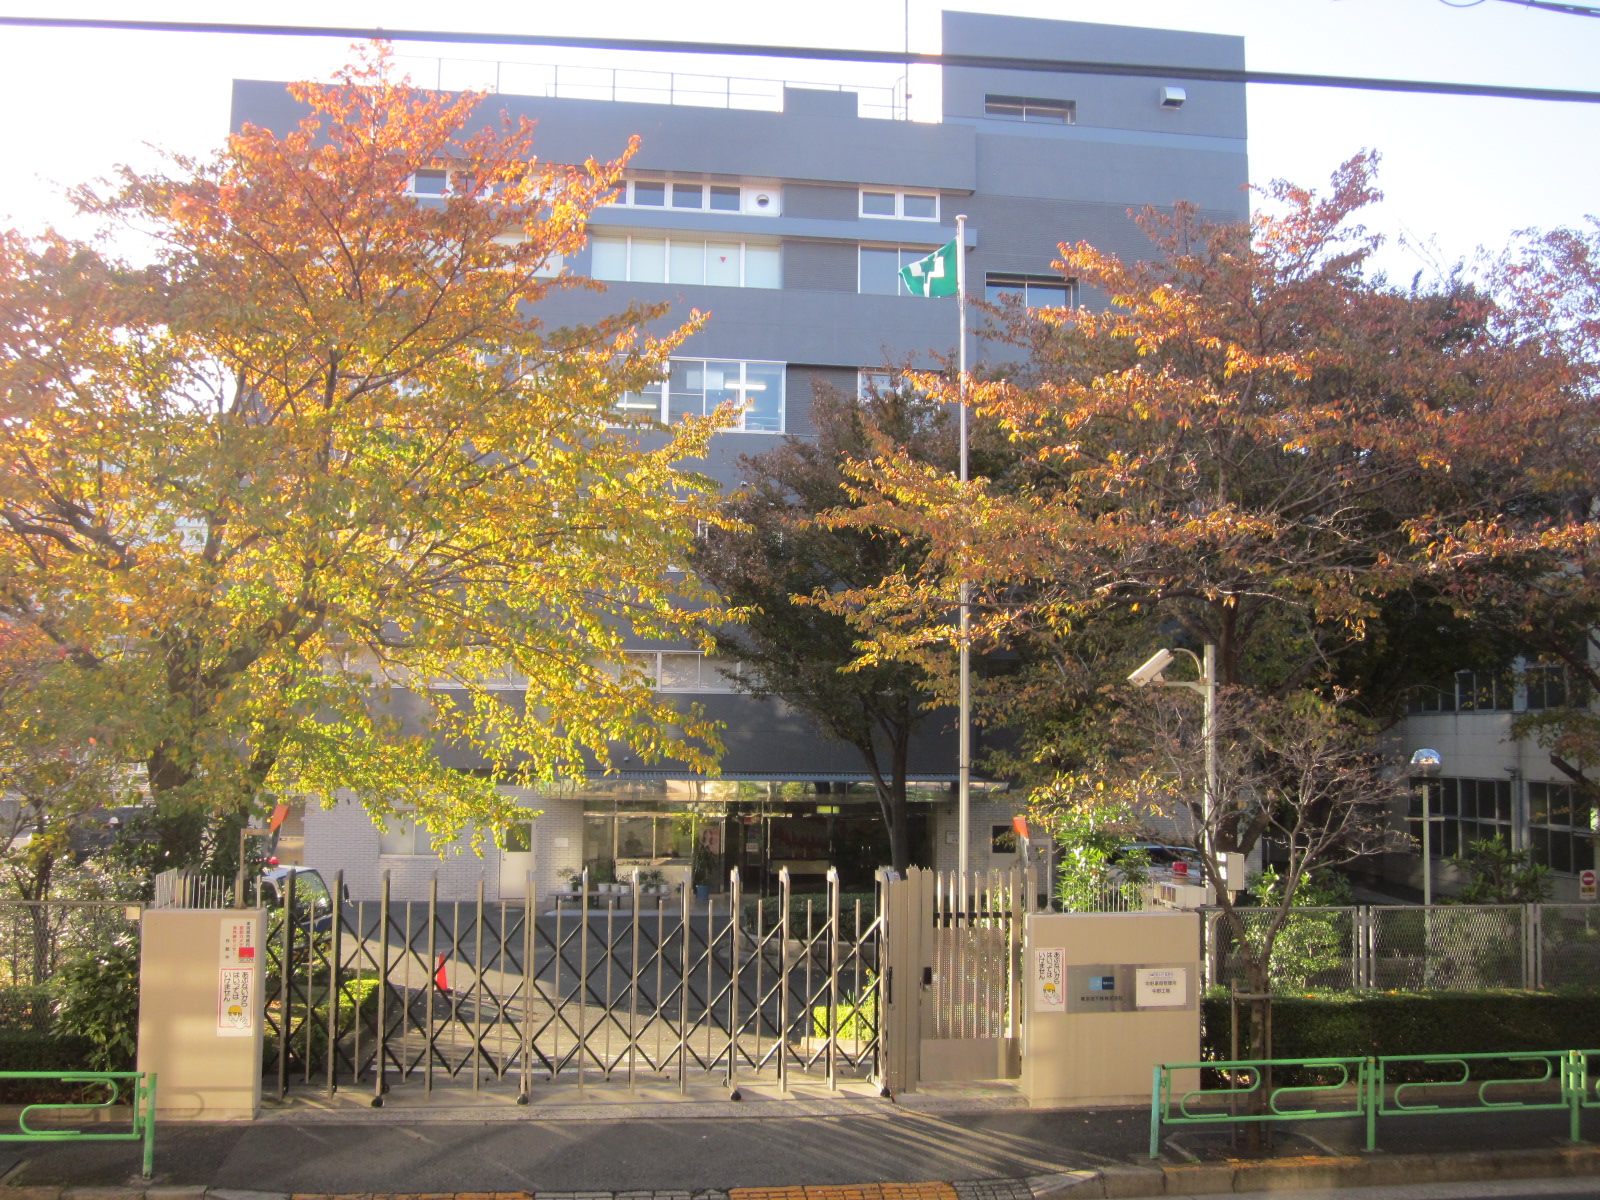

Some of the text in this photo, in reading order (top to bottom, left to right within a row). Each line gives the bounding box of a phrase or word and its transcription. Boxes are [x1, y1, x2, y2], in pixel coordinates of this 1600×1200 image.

[1038, 951, 1046, 981] いけません
[223, 971, 232, 1002] いけません
[232, 971, 240, 1000] はいっては
[241, 971, 249, 1008] あぶないから
